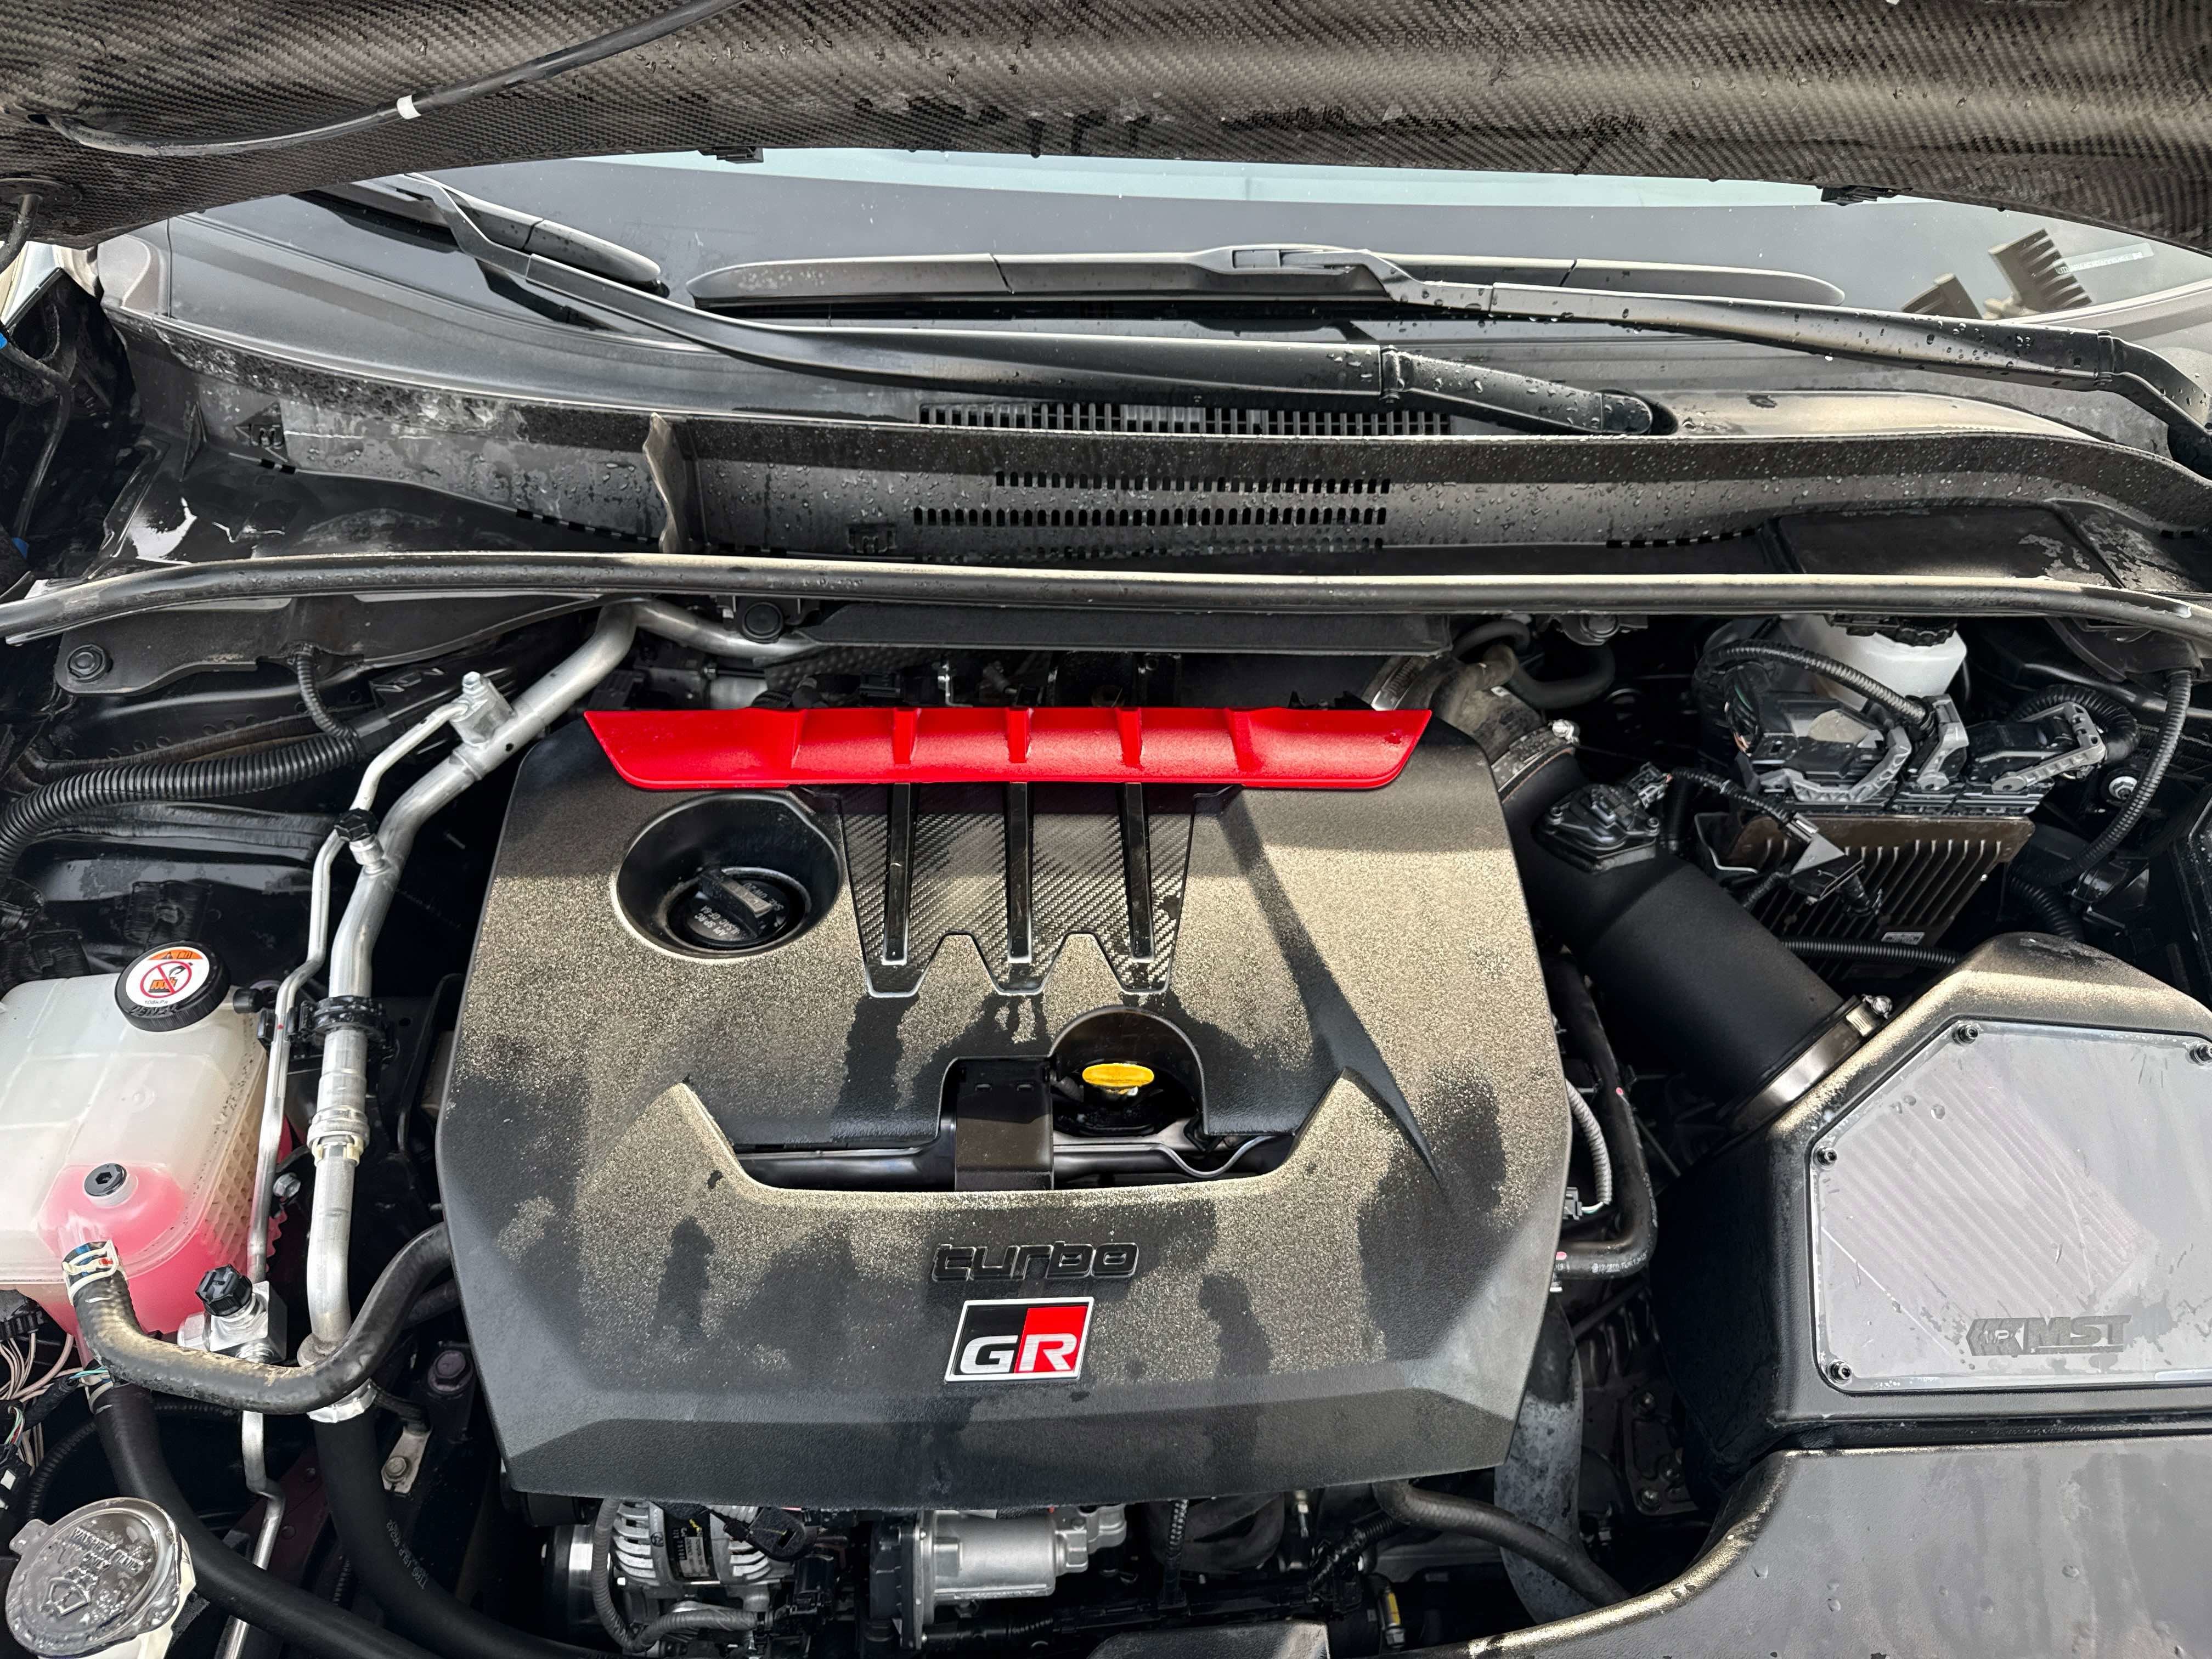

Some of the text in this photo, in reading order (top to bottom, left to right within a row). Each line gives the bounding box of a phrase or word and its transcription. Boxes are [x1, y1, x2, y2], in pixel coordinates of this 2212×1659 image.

[713, 927, 728, 936] API
[931, 1240, 1139, 1282] turbo
[2025, 1315, 2132, 1345] MST
[960, 1333, 1077, 1374] GR
